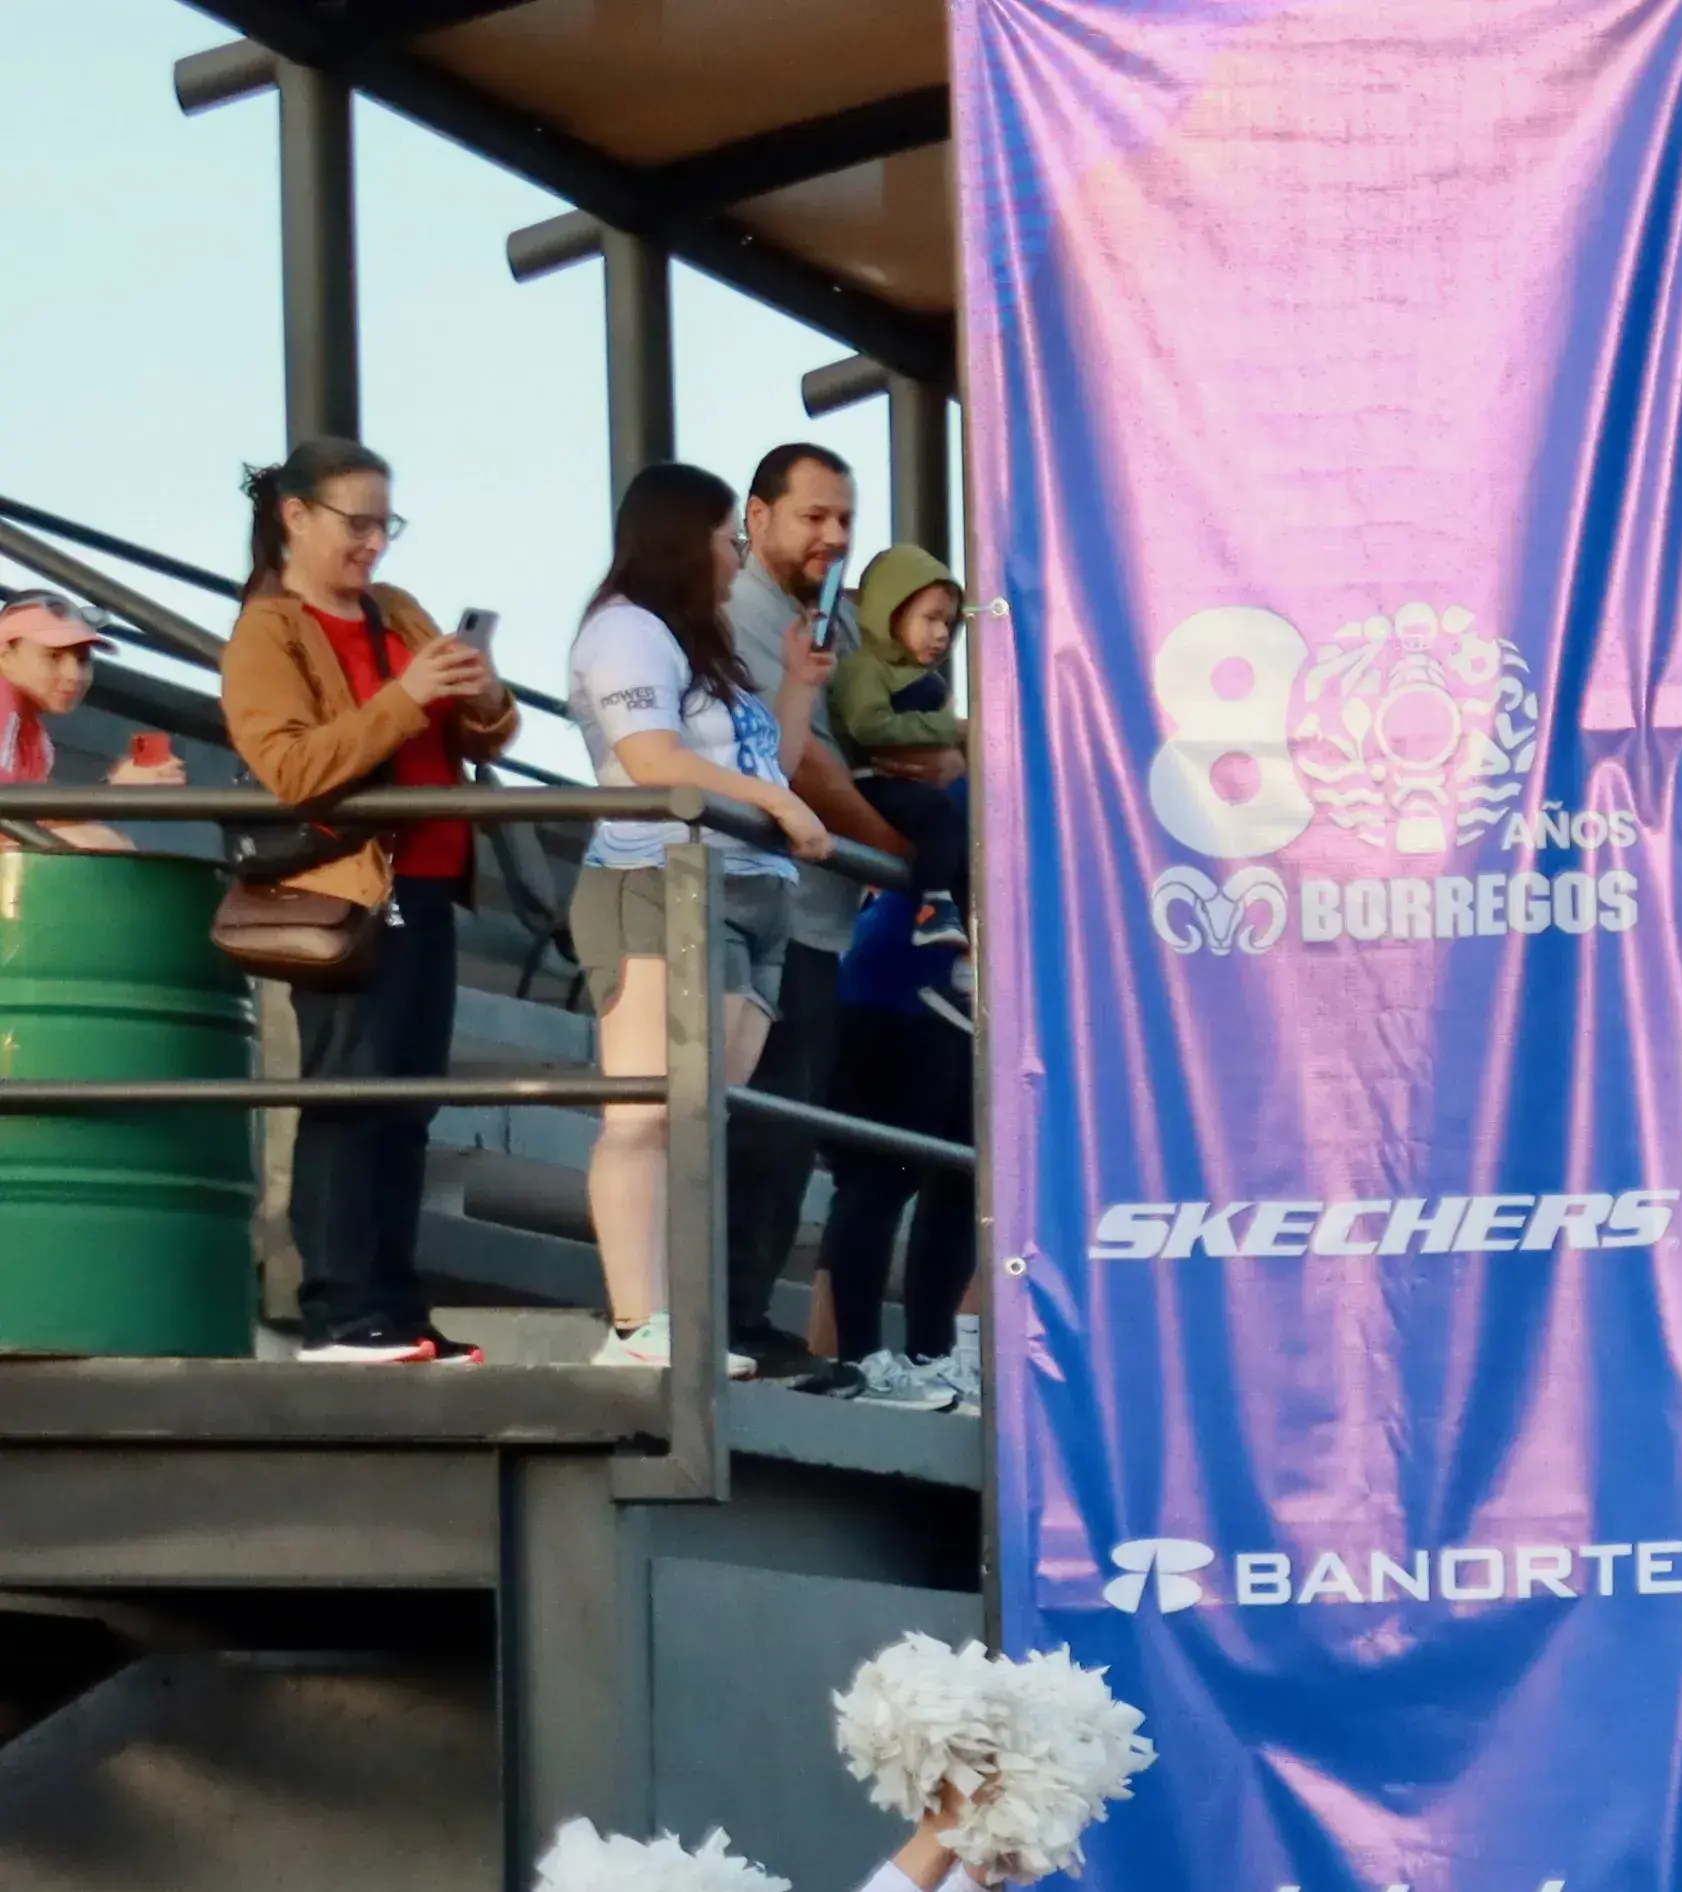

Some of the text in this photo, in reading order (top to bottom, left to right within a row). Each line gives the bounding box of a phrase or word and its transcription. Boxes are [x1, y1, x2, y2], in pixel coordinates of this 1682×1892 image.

[1502, 801, 1639, 851] AÑOS
[1302, 869, 1640, 943] BORREGOS
[1089, 1189, 1681, 1260] SKECHERS
